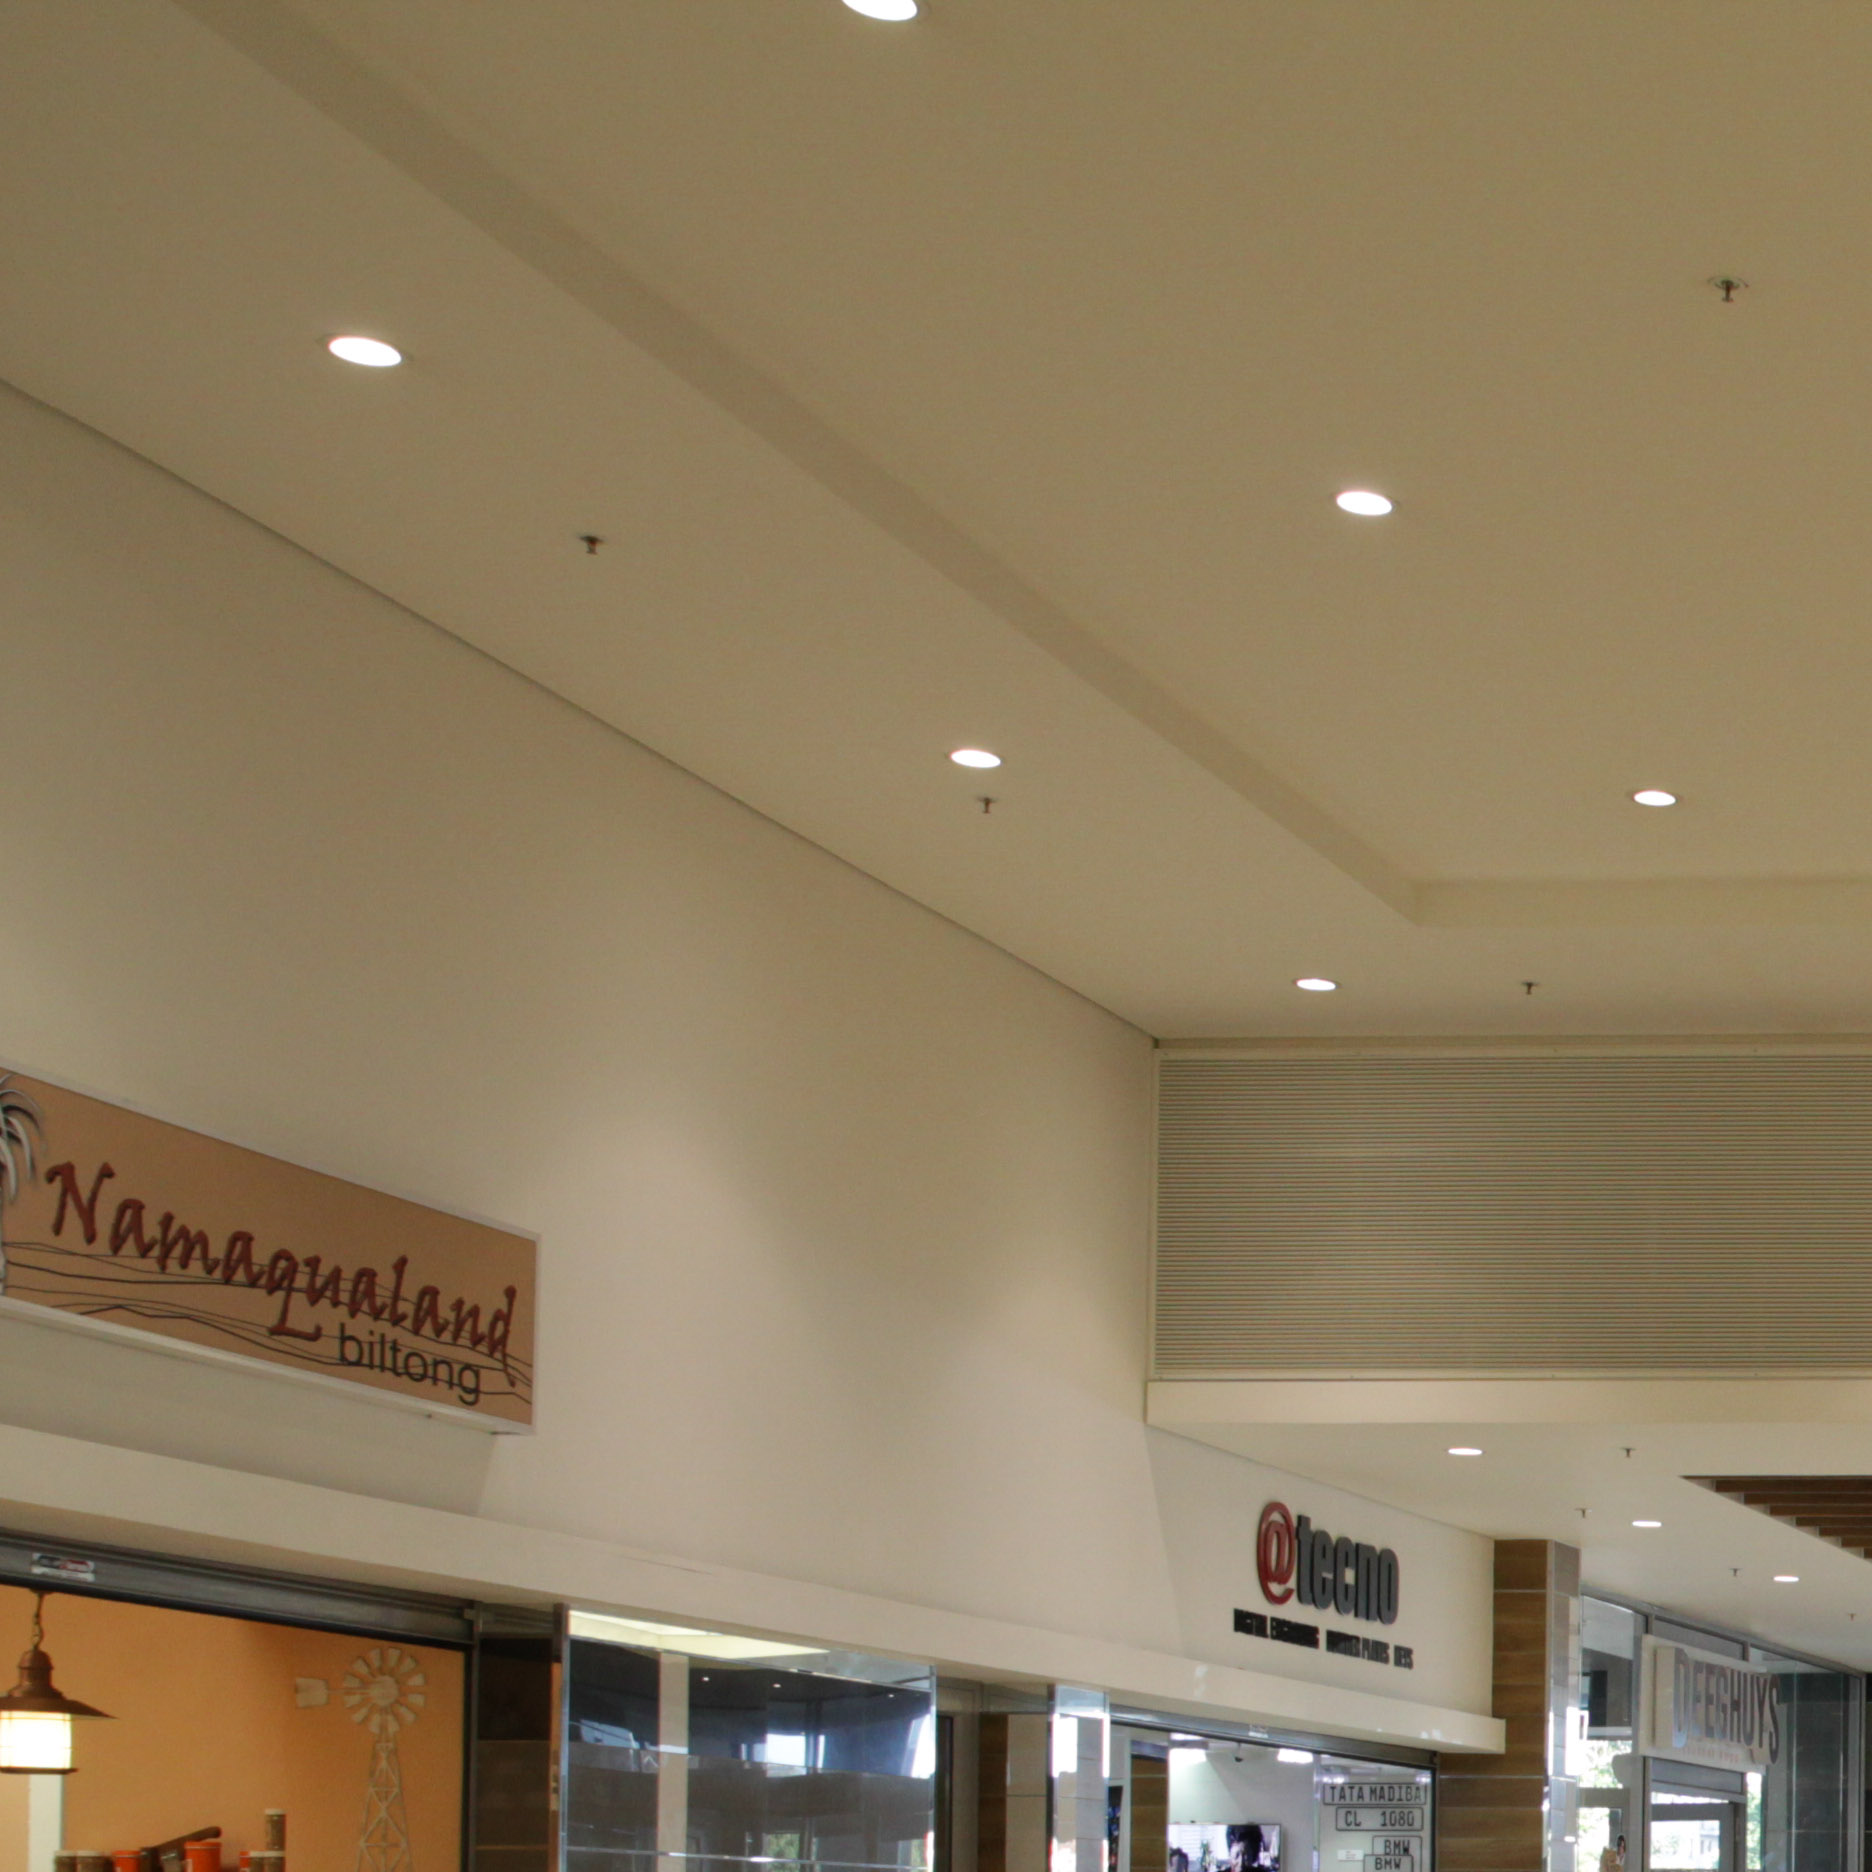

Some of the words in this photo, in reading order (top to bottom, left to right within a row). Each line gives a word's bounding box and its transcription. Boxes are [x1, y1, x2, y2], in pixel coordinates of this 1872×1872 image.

[45, 1161, 517, 1387] Namaqualand
[339, 1323, 481, 1406] biltong
[1330, 1786, 1364, 1802] TATA
[1369, 1786, 1421, 1802] MADIBA
[1344, 1810, 1361, 1827] CL
[1380, 1810, 1415, 1827] 1080
[1384, 1840, 1410, 1855] BMW
[1374, 1857, 1402, 1870] BMW
